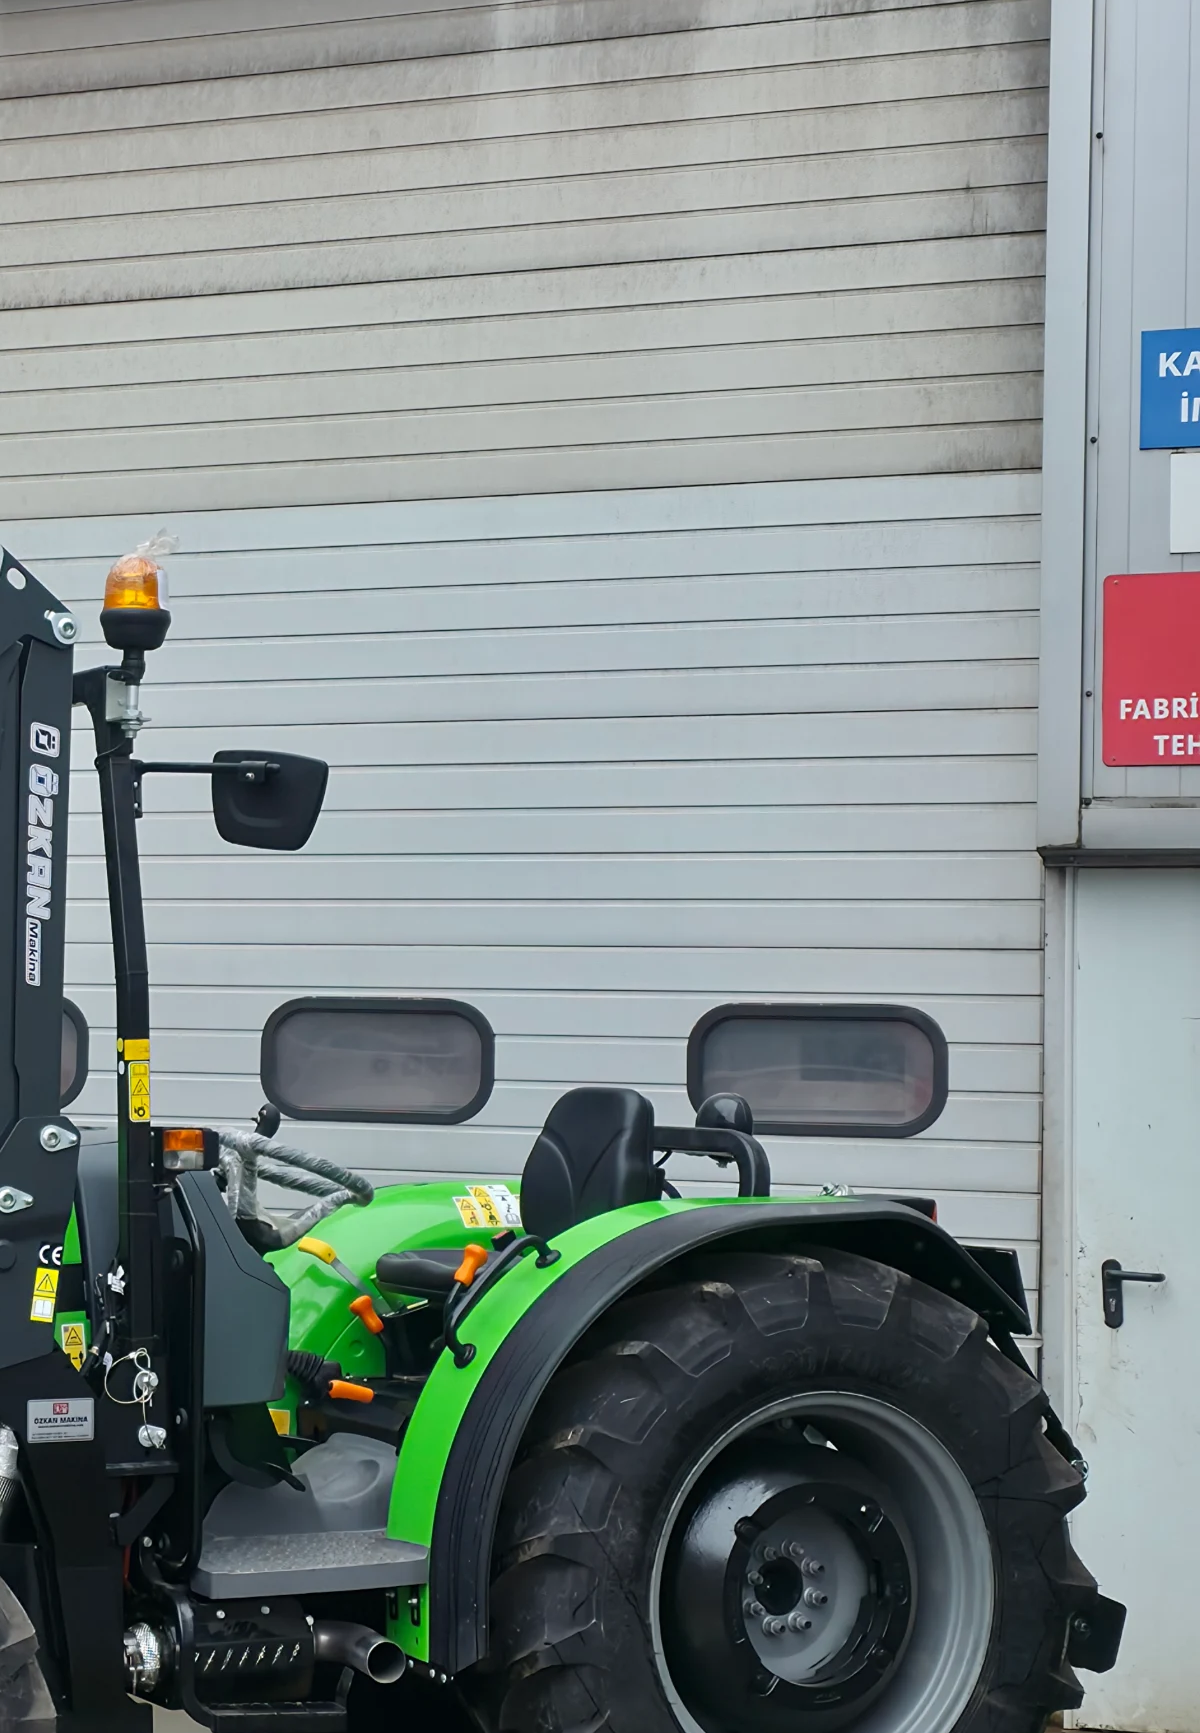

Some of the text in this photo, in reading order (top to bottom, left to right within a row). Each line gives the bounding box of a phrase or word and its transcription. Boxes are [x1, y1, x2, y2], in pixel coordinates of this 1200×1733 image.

[1120, 692, 1199, 720] FABRİ
[26, 764, 59, 919] ÖZKAN
[28, 921, 39, 982] Makina
